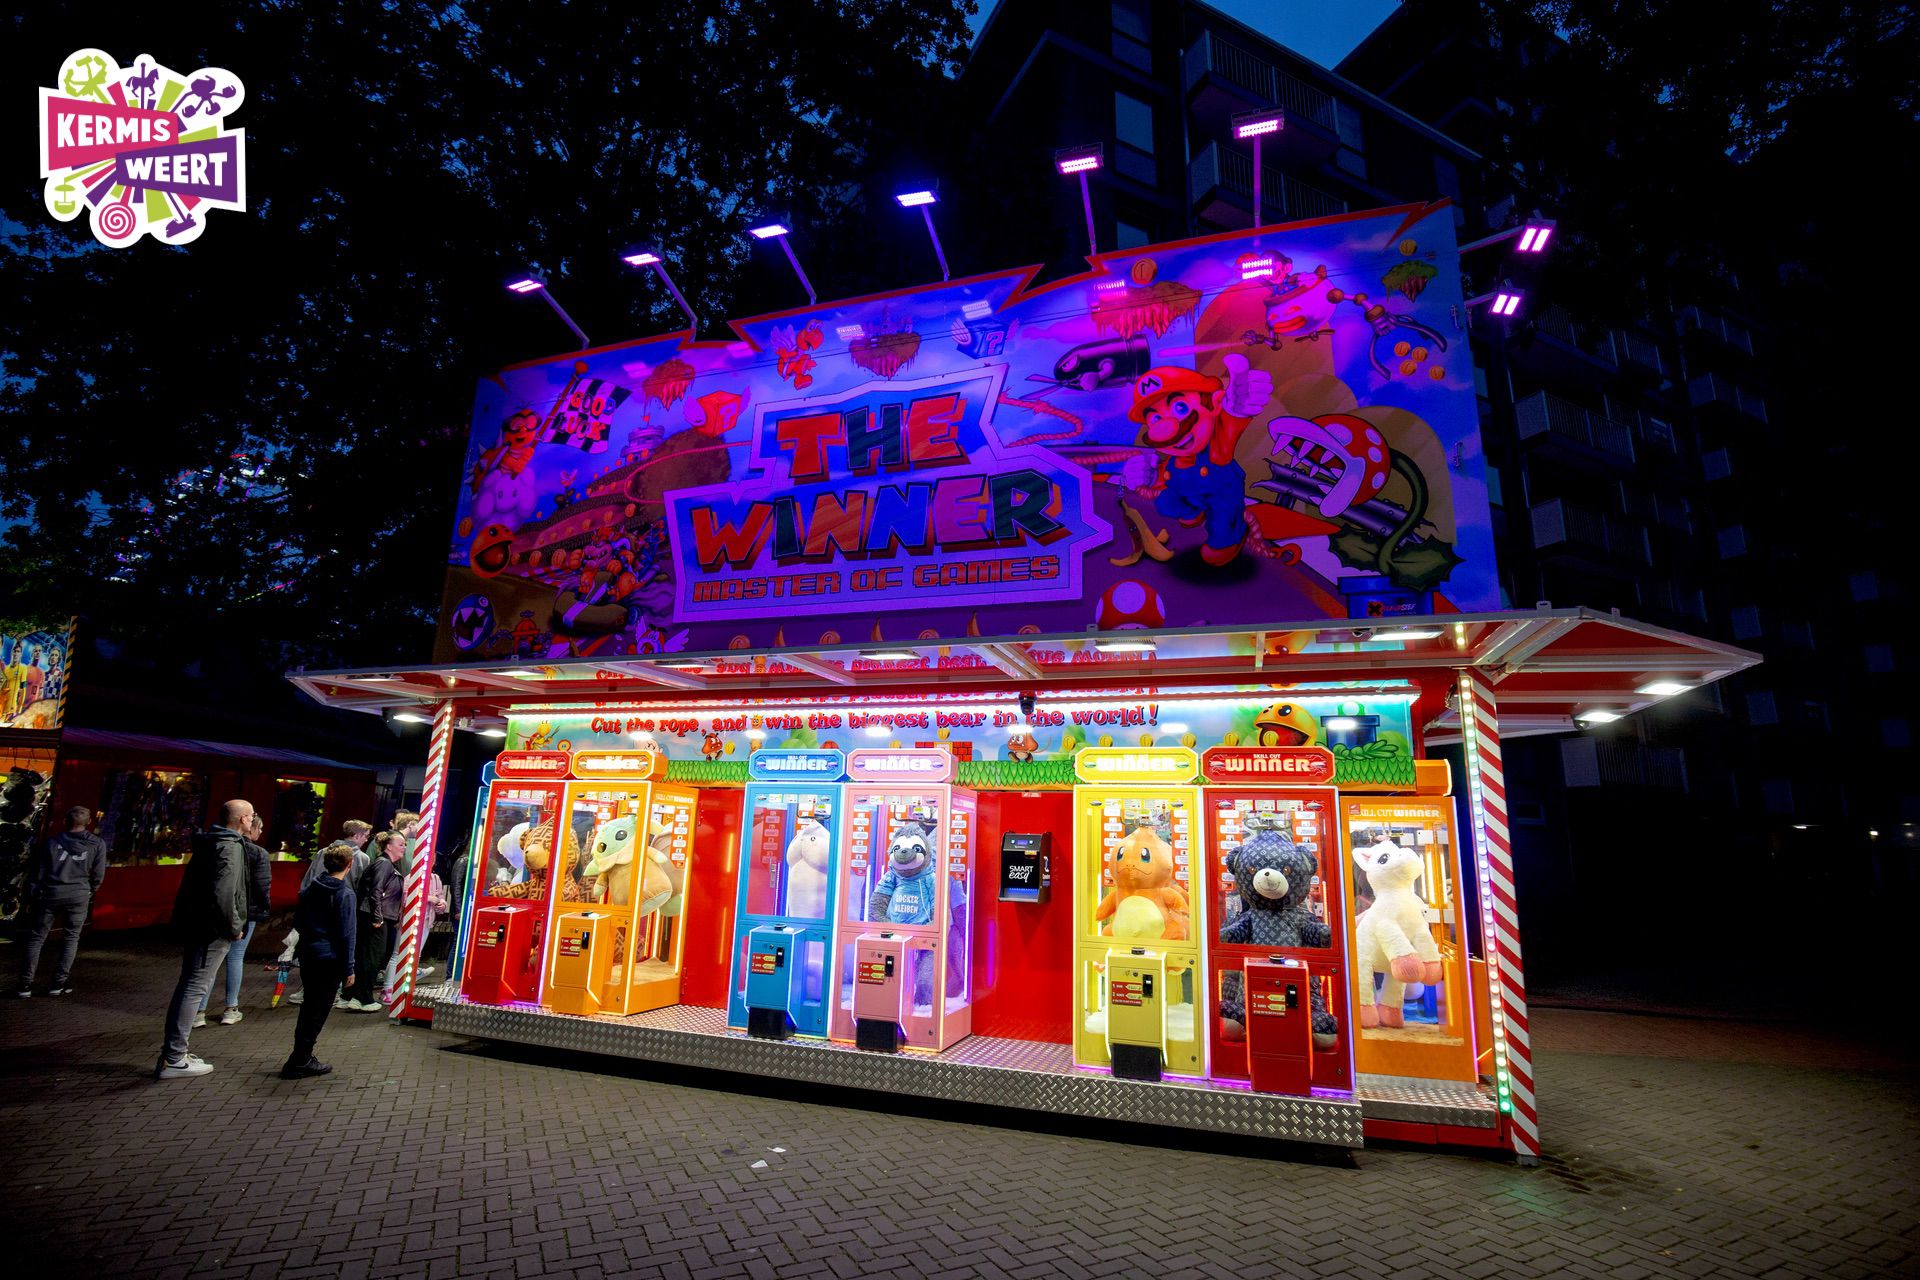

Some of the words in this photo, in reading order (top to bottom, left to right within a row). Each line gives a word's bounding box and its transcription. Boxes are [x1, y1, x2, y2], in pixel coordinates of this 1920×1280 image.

[571, 391, 616, 415] GOOD
[556, 415, 606, 441] LUCK
[776, 392, 968, 482] THE
[690, 468, 1068, 570] WINNER
[692, 571, 841, 603] MASTER
[913, 555, 1060, 588] GAMES
[591, 717, 622, 734] Cut
[626, 717, 655, 733] the
[712, 714, 747, 731] and
[765, 713, 804, 730] win
[808, 712, 842, 730] the
[848, 711, 929, 731] biggest
[935, 710, 987, 729] bear
[993, 709, 1018, 727] in
[1026, 709, 1065, 727] the
[508, 759, 558, 770] WINNER
[765, 759, 829, 771] WINNER
[864, 758, 933, 771] WINNER
[1096, 757, 1176, 772] WINNER
[1225, 758, 1312, 772] WINNER
[1377, 808, 1393, 817] CUT
[1393, 809, 1440, 818] WINNER
[1009, 865, 1034, 873] SMART
[1008, 870, 1030, 884] easy
